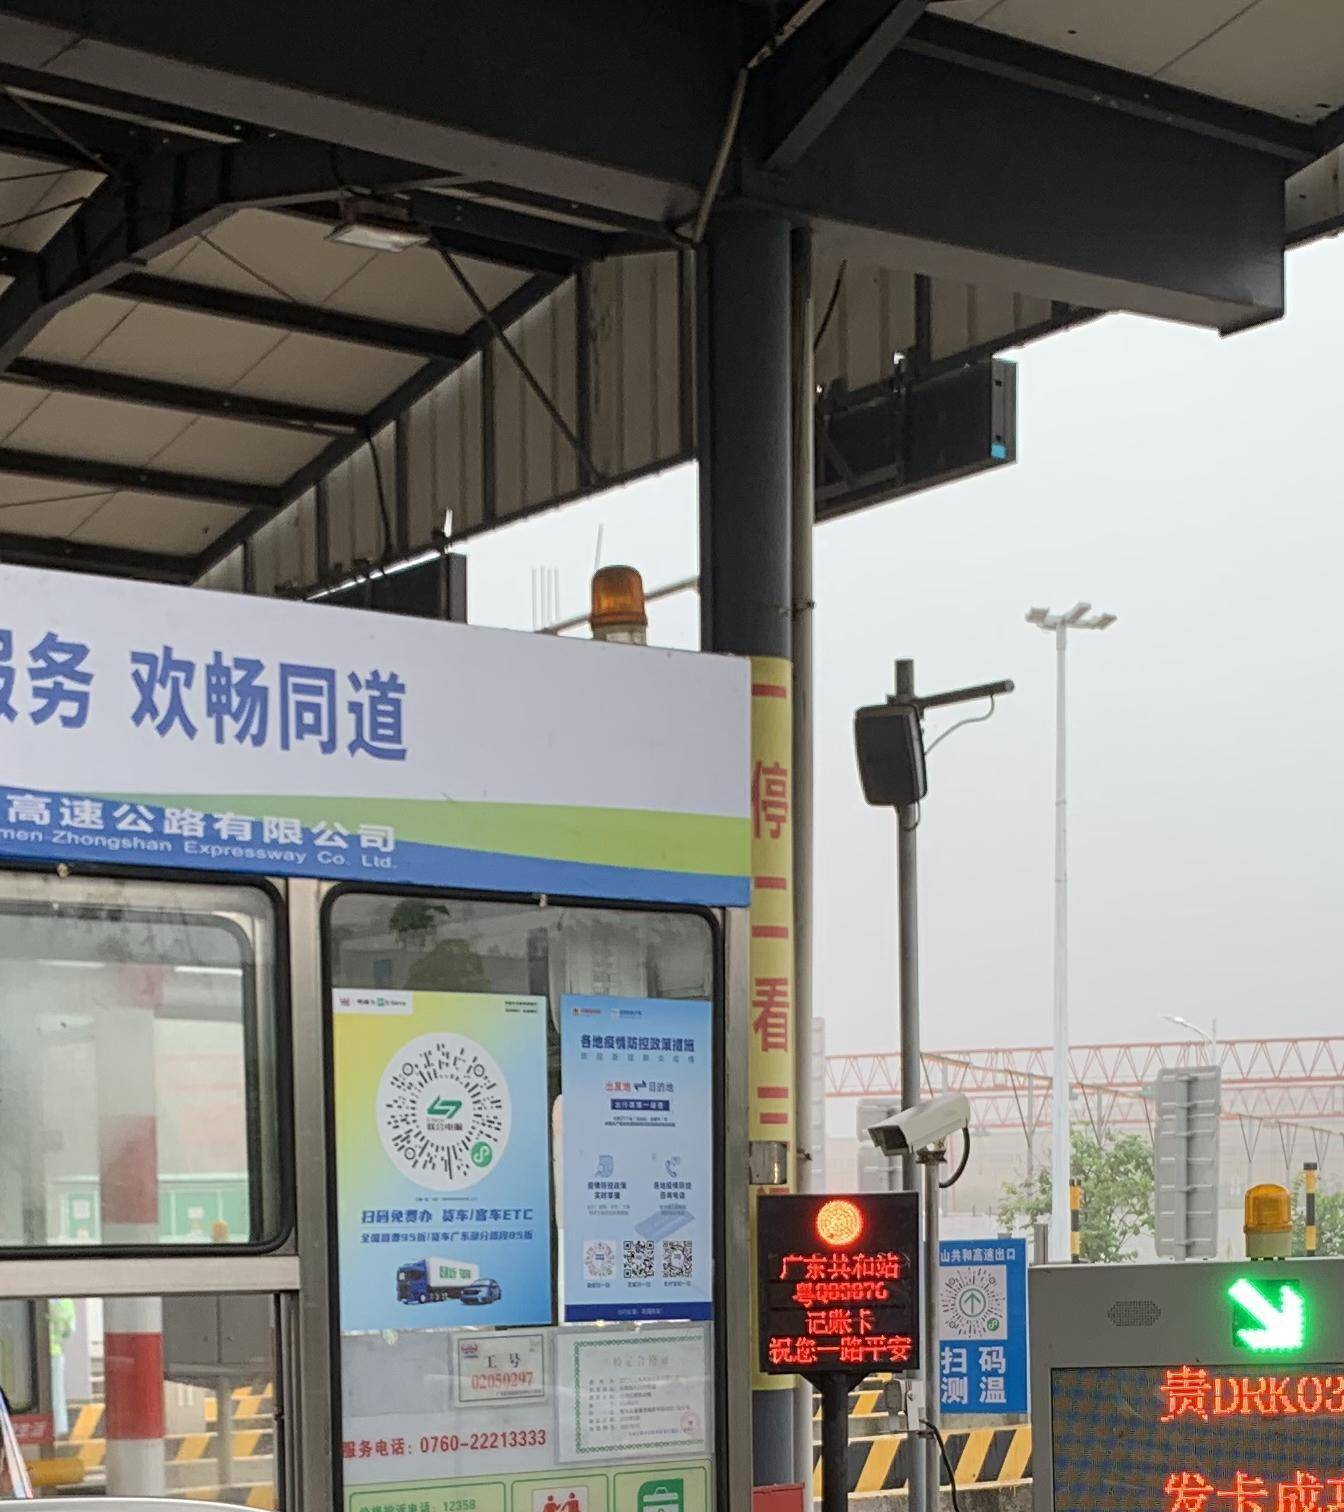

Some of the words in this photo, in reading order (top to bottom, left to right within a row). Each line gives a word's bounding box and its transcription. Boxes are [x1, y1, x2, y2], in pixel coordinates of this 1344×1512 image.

[131, 645, 409, 762] 欢畅同道
[184, 840, 306, 865] Expressway
[317, 850, 351, 866] Co.
[361, 854, 398, 869] Ltd.
[581, 1034, 695, 1053] 各地疫情防控政策措施
[361, 1208, 433, 1224] 扫码免费办
[441, 1208, 534, 1223] 货车/客车ETC
[780, 1252, 901, 1280] 广东共和站
[768, 1335, 912, 1364] 祝您一路平安
[941, 1347, 1006, 1374] 扫码
[940, 1377, 1007, 1404] 测温
